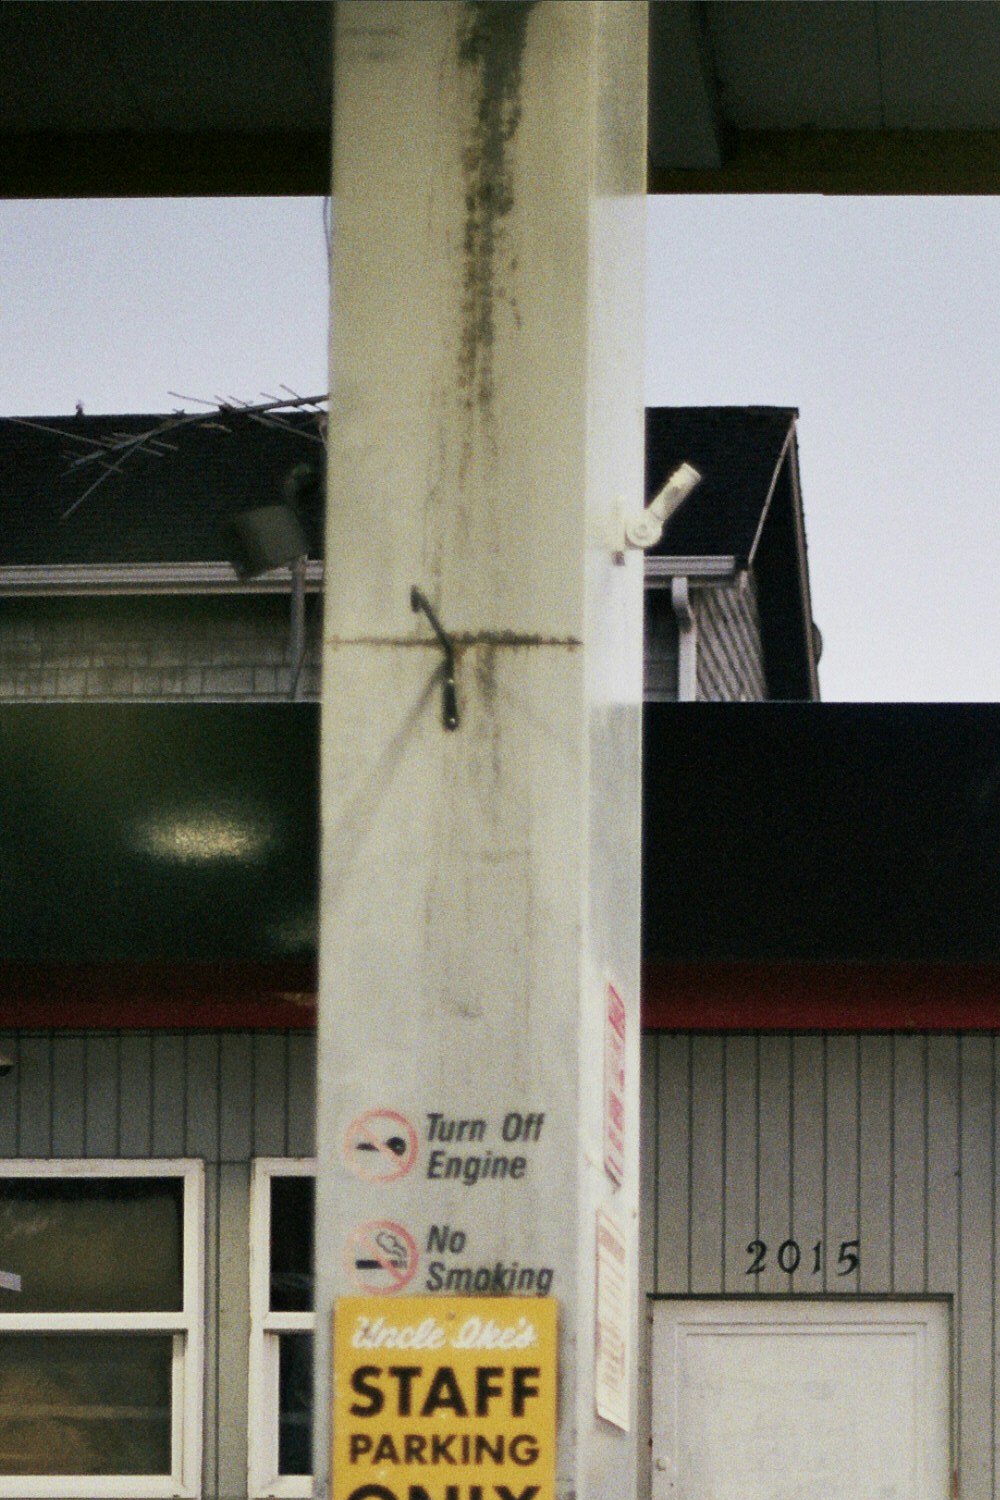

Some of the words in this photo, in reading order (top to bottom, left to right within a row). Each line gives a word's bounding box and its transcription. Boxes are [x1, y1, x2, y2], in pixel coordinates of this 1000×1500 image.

[426, 1112, 487, 1142] Turn
[502, 1111, 545, 1142] Off
[426, 1150, 527, 1185] Engine
[426, 1225, 467, 1253] No
[745, 1239, 860, 1276] 2015
[426, 1261, 554, 1297] Smoking
[352, 1316, 446, 1349] Uncle
[451, 1316, 536, 1349] Ike's
[350, 1365, 540, 1418] STAFF
[350, 1434, 540, 1467] PARKING
